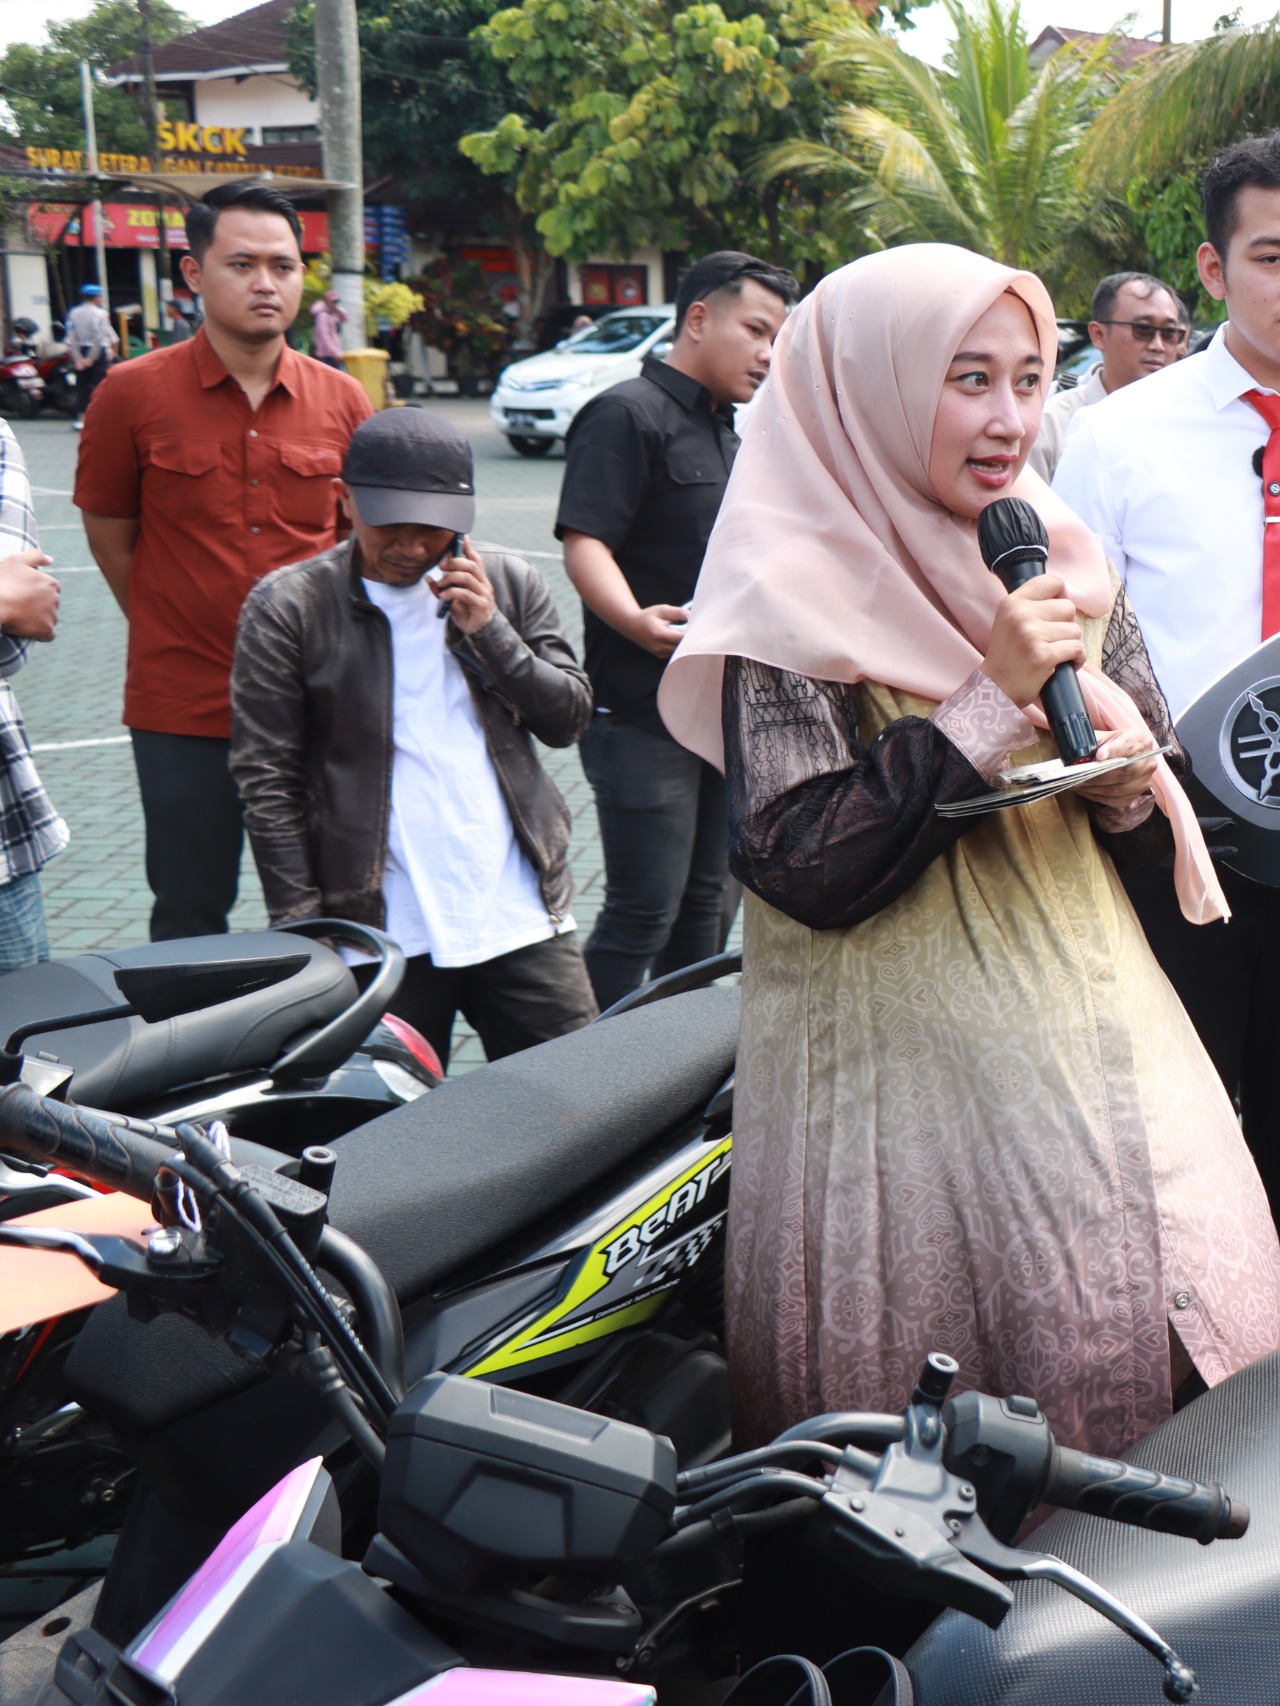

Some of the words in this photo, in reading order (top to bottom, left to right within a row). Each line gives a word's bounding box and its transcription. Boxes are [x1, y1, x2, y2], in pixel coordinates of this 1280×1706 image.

[156, 121, 248, 155] SKCK
[26, 146, 82, 171] SURAT
[86, 152, 201, 175] ETERAGAN
